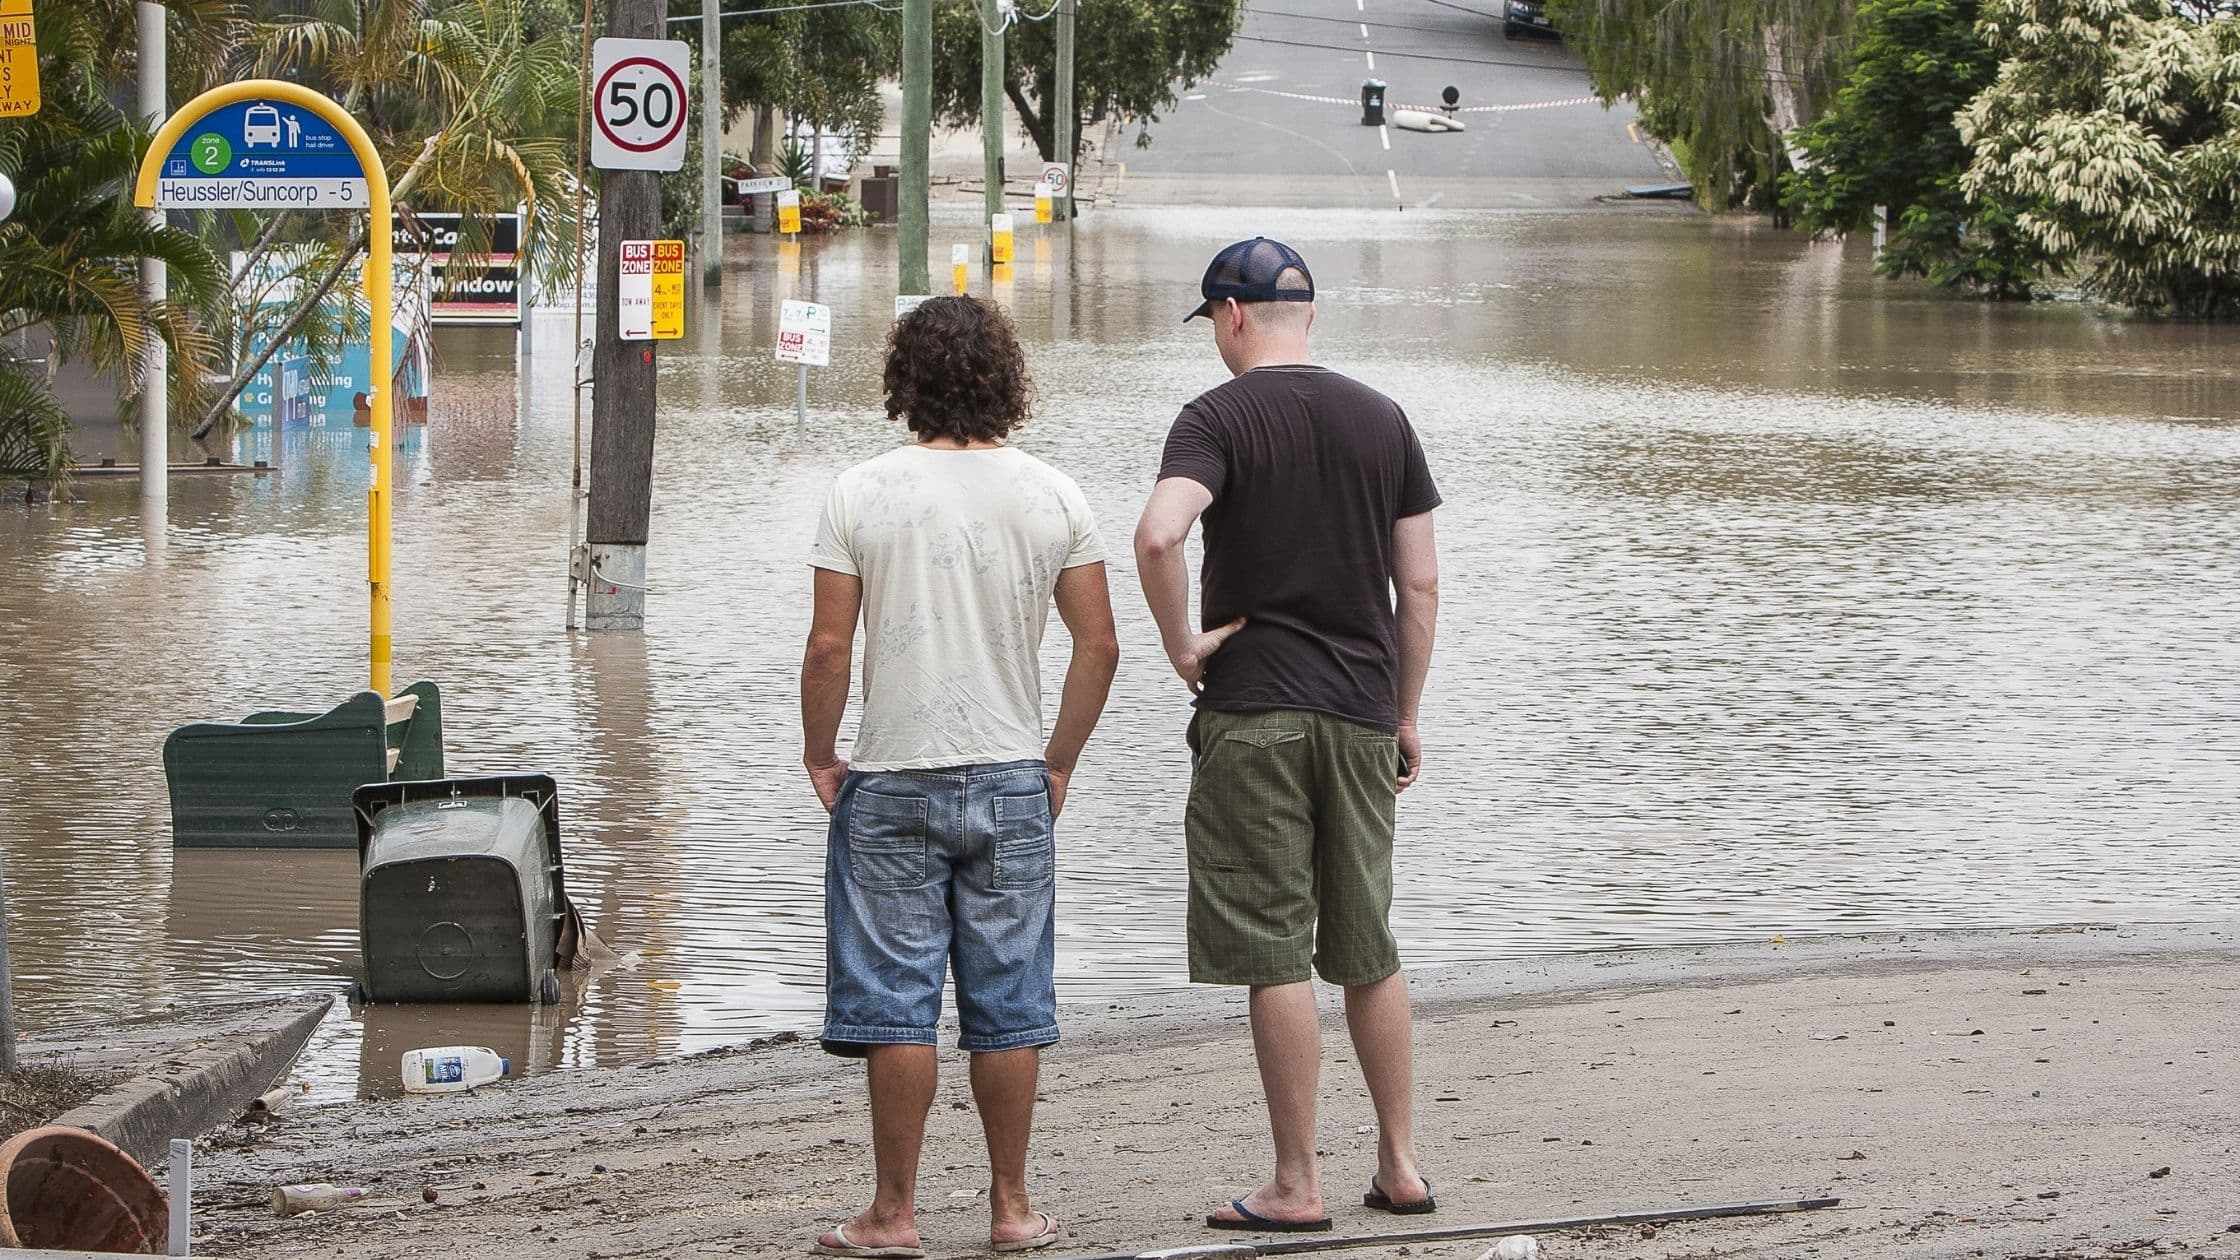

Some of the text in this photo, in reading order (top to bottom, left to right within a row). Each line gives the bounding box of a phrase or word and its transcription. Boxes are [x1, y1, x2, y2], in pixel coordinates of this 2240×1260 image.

[4, 23, 31, 39] MID
[4, 38, 33, 47] NIGHT
[0, 101, 32, 112] WAY
[609, 81, 673, 129] 50
[305, 141, 334, 149] hail driver
[317, 134, 332, 143] stop
[204, 146, 218, 165] 2
[1047, 172, 1064, 186] 50
[161, 180, 318, 206] Heussler/Suncorp
[625, 244, 648, 259] BUS
[657, 244, 679, 258] BUS
[622, 260, 650, 274] ZONE
[654, 260, 682, 273] ZONE
[783, 332, 801, 342] BUS
[779, 341, 803, 351] ZONE
